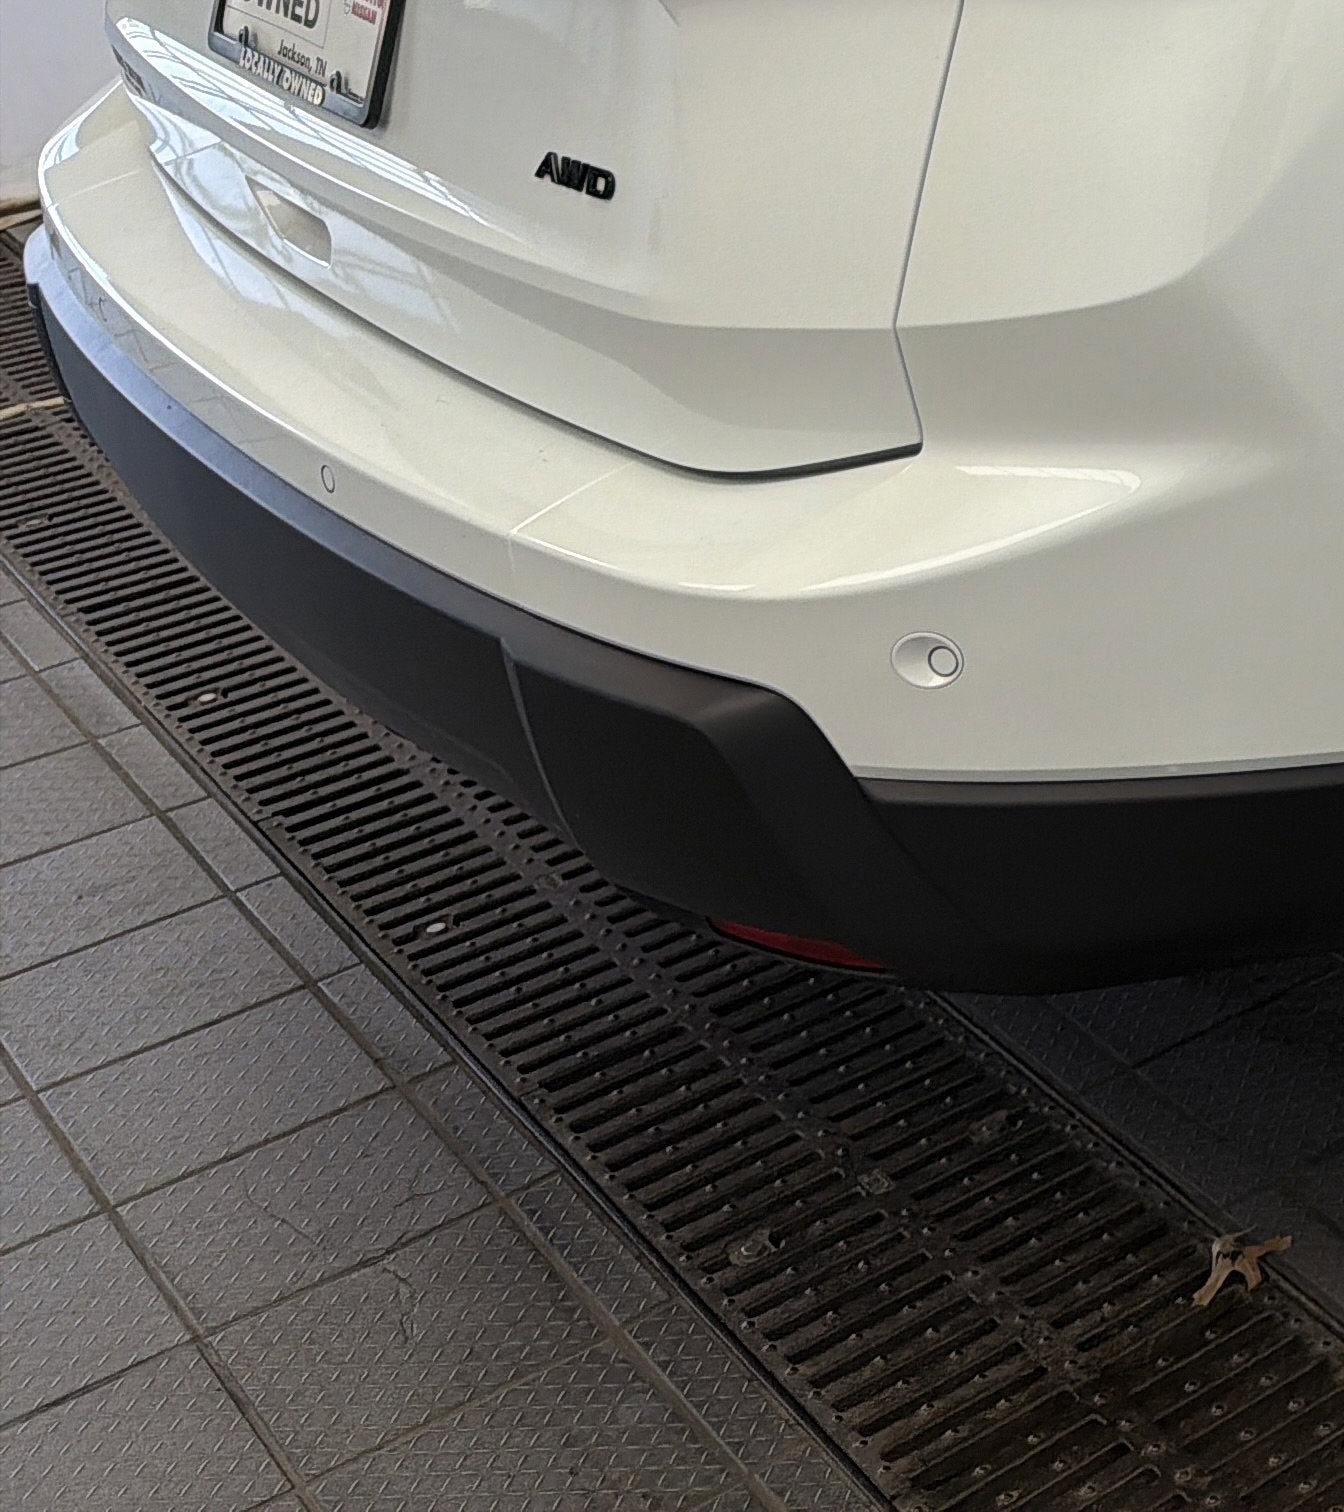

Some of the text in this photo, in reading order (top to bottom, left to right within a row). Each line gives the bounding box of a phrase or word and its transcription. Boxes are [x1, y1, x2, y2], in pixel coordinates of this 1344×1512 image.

[239, 46, 324, 106] LOCALLY OWNED
[278, 39, 328, 78] Jackson, TN
[534, 151, 616, 201] AWD
